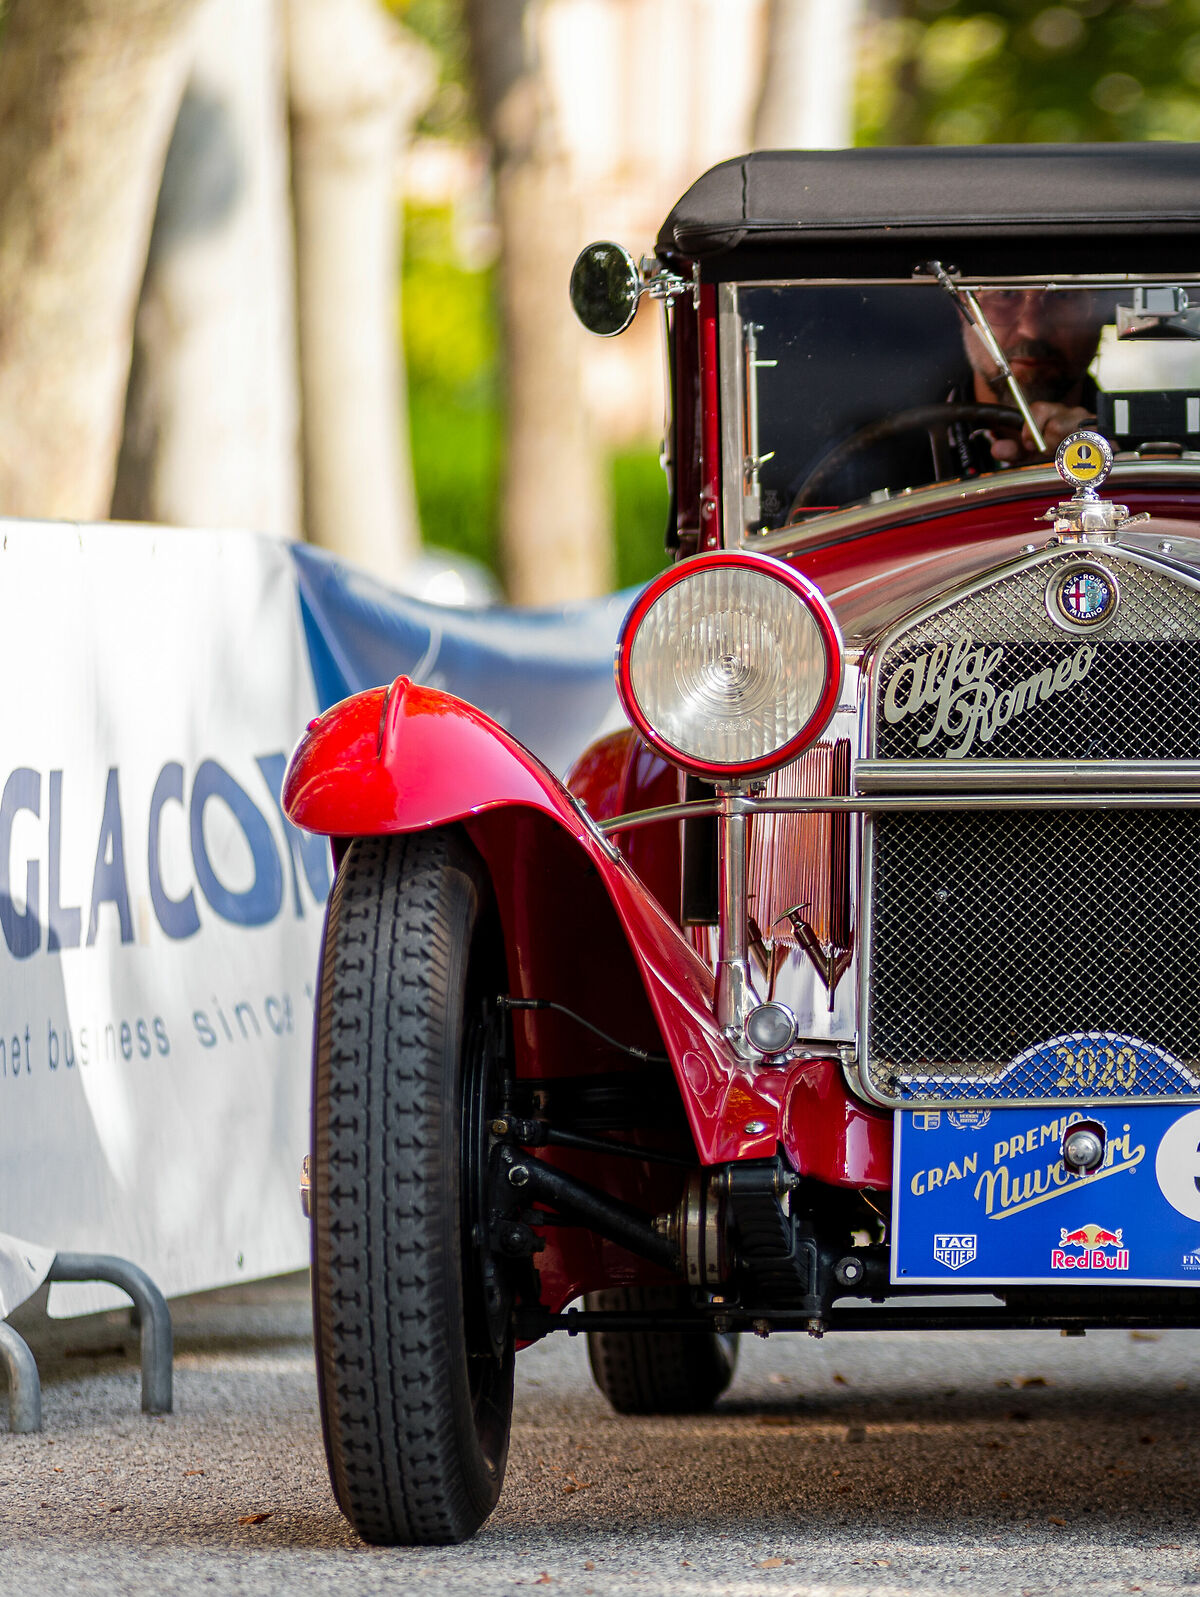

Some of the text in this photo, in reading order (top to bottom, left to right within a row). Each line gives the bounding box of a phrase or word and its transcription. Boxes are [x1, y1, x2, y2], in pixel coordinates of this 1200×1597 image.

[1070, 607, 1103, 618] MILANO
[884, 633, 1004, 748] Alfa
[945, 645, 1097, 758] Romeo
[1056, 1047, 1137, 1088] 2020
[910, 1152, 978, 1196] GRAN
[937, 1237, 973, 1248] TAG
[936, 1249, 974, 1268] HEUER
[1052, 1250, 1129, 1270] Red Bull
